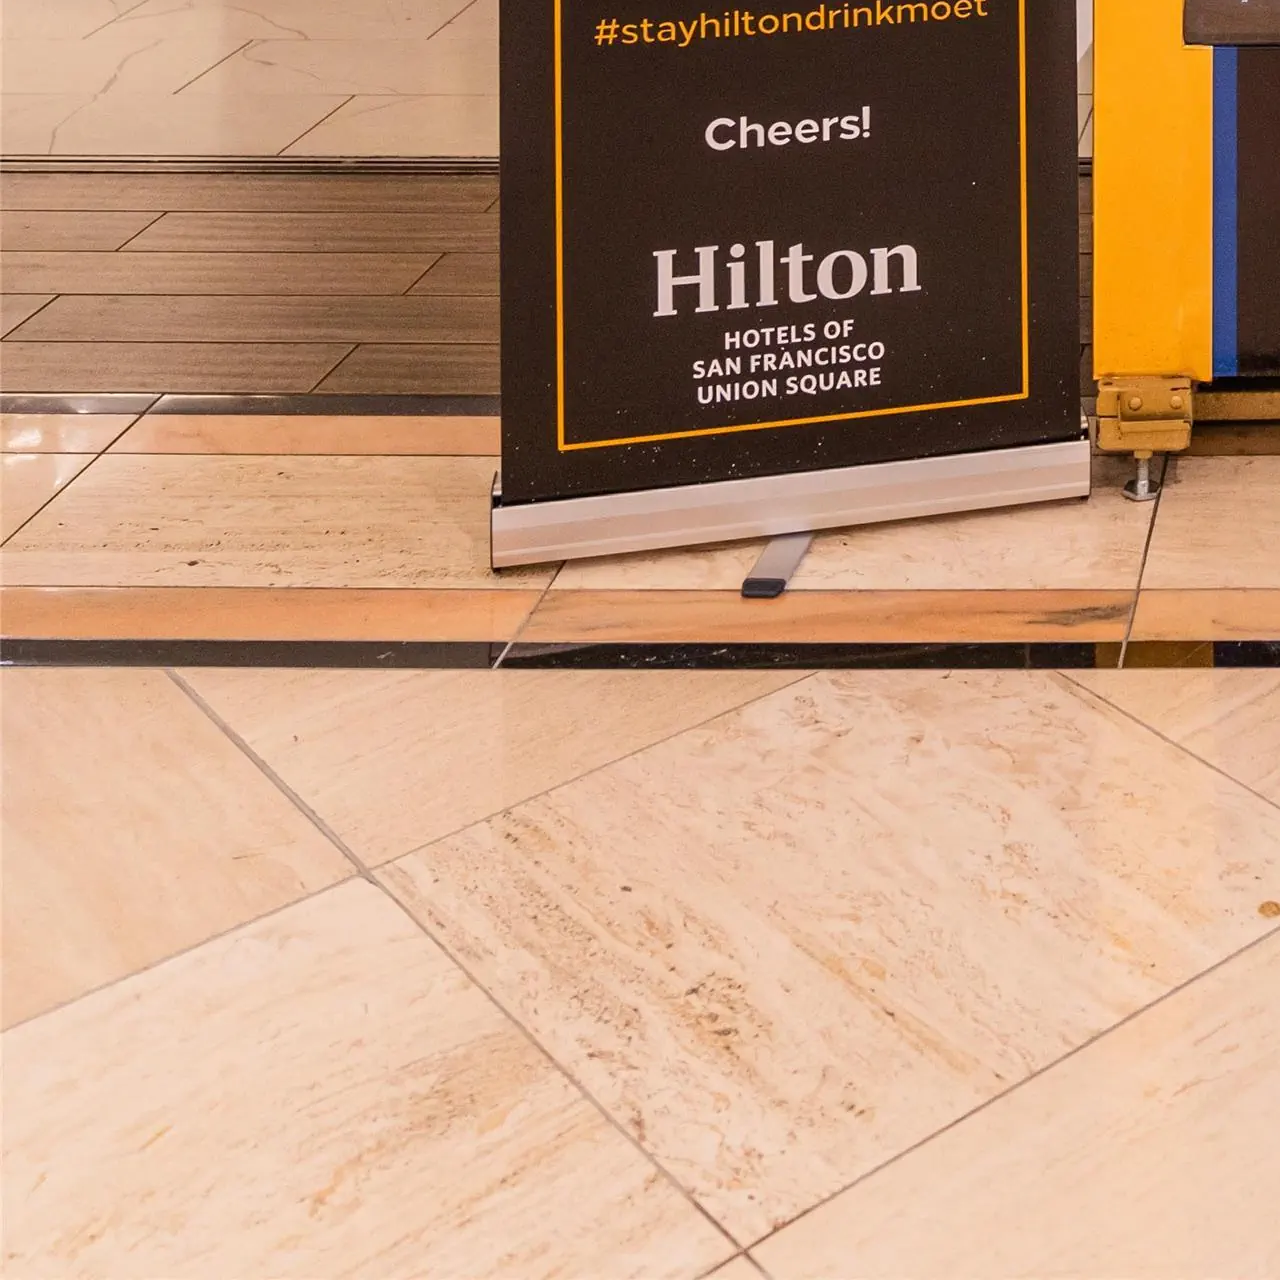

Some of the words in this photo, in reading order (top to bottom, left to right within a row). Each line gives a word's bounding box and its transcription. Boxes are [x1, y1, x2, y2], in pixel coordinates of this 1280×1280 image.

[704, 105, 871, 151] Cheers!
[652, 239, 922, 318] Hilton
[724, 322, 817, 351] HOTELS
[823, 319, 855, 340] OF
[692, 357, 741, 380] SAN
[749, 341, 886, 374] FRANCISCO
[697, 379, 777, 405] UNION
[786, 367, 882, 397] SQUARE
